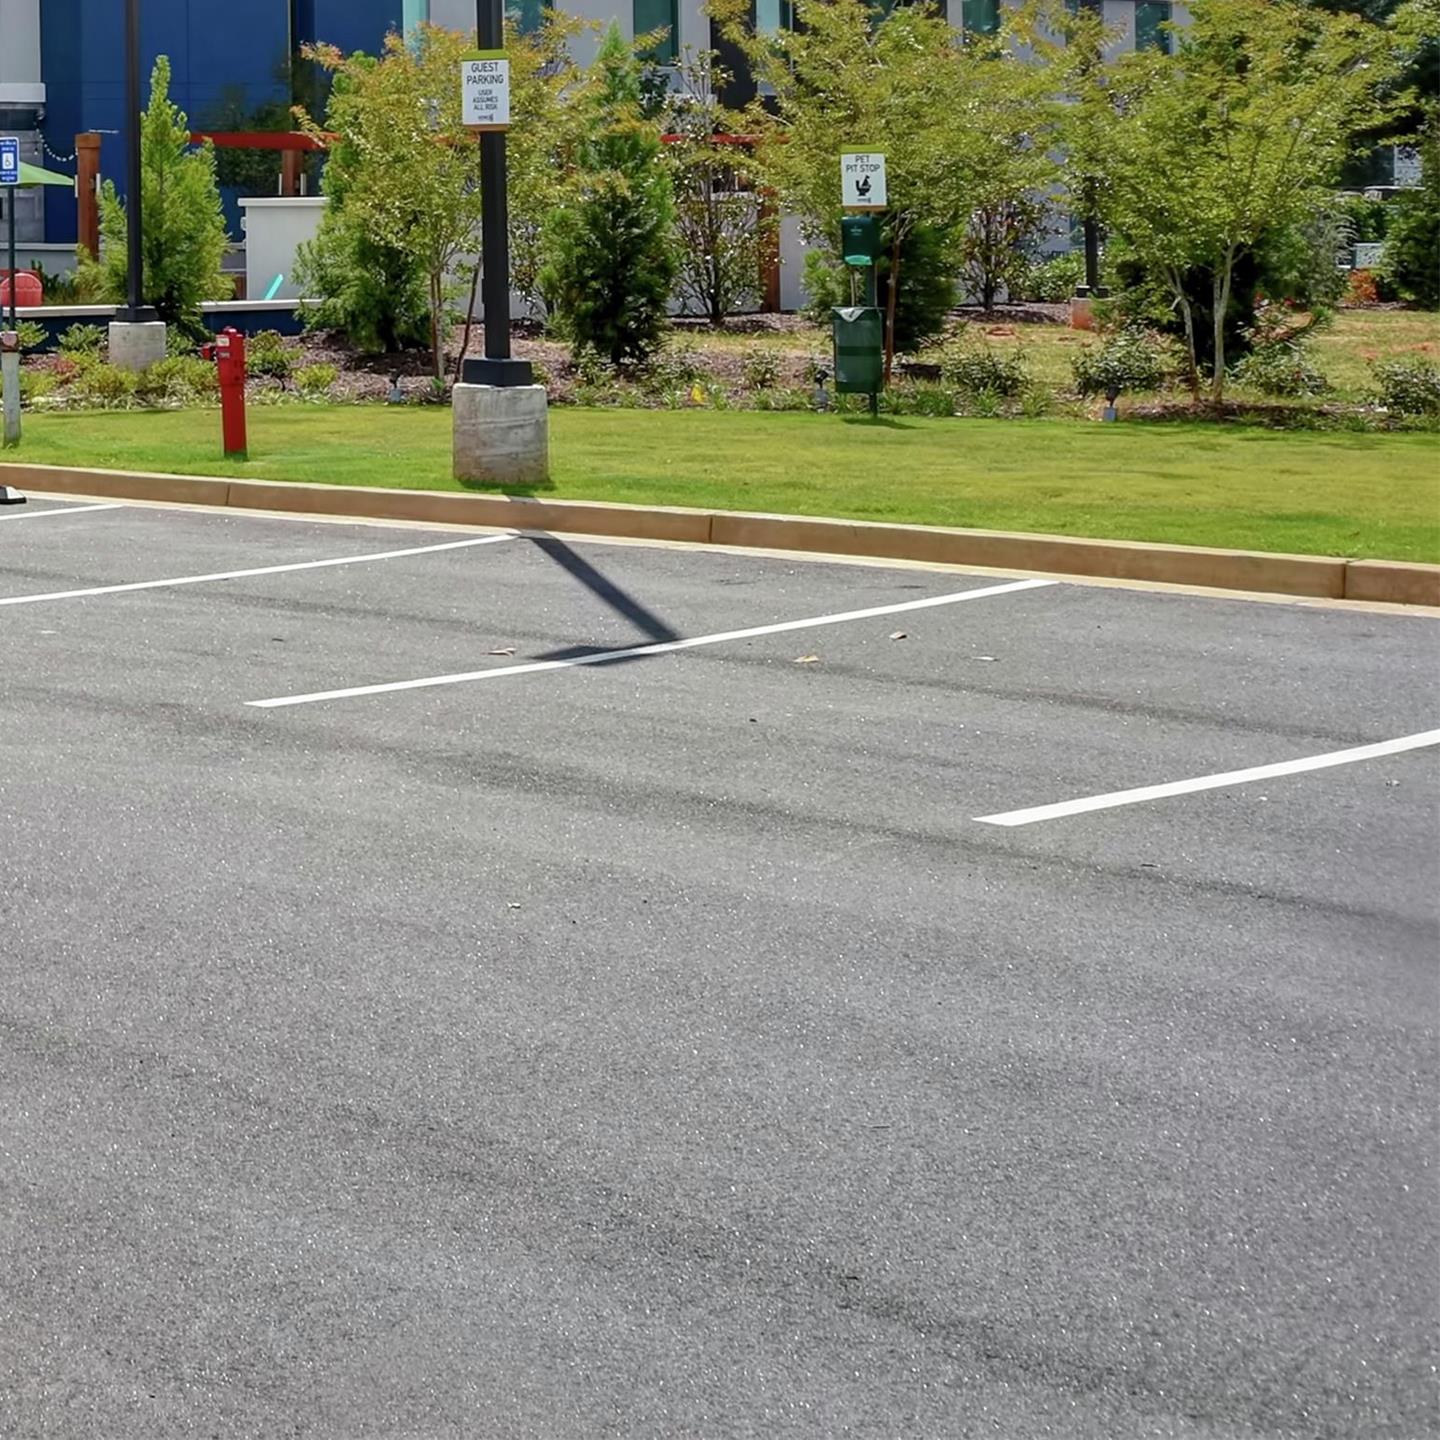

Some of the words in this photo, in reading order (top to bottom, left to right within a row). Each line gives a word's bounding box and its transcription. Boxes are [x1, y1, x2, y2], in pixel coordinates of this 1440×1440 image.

[471, 62, 499, 73] GUEST
[466, 74, 504, 85] PARKING
[855, 155, 870, 164] PET
[845, 164, 858, 173] PIT
[859, 164, 881, 173] STOP
